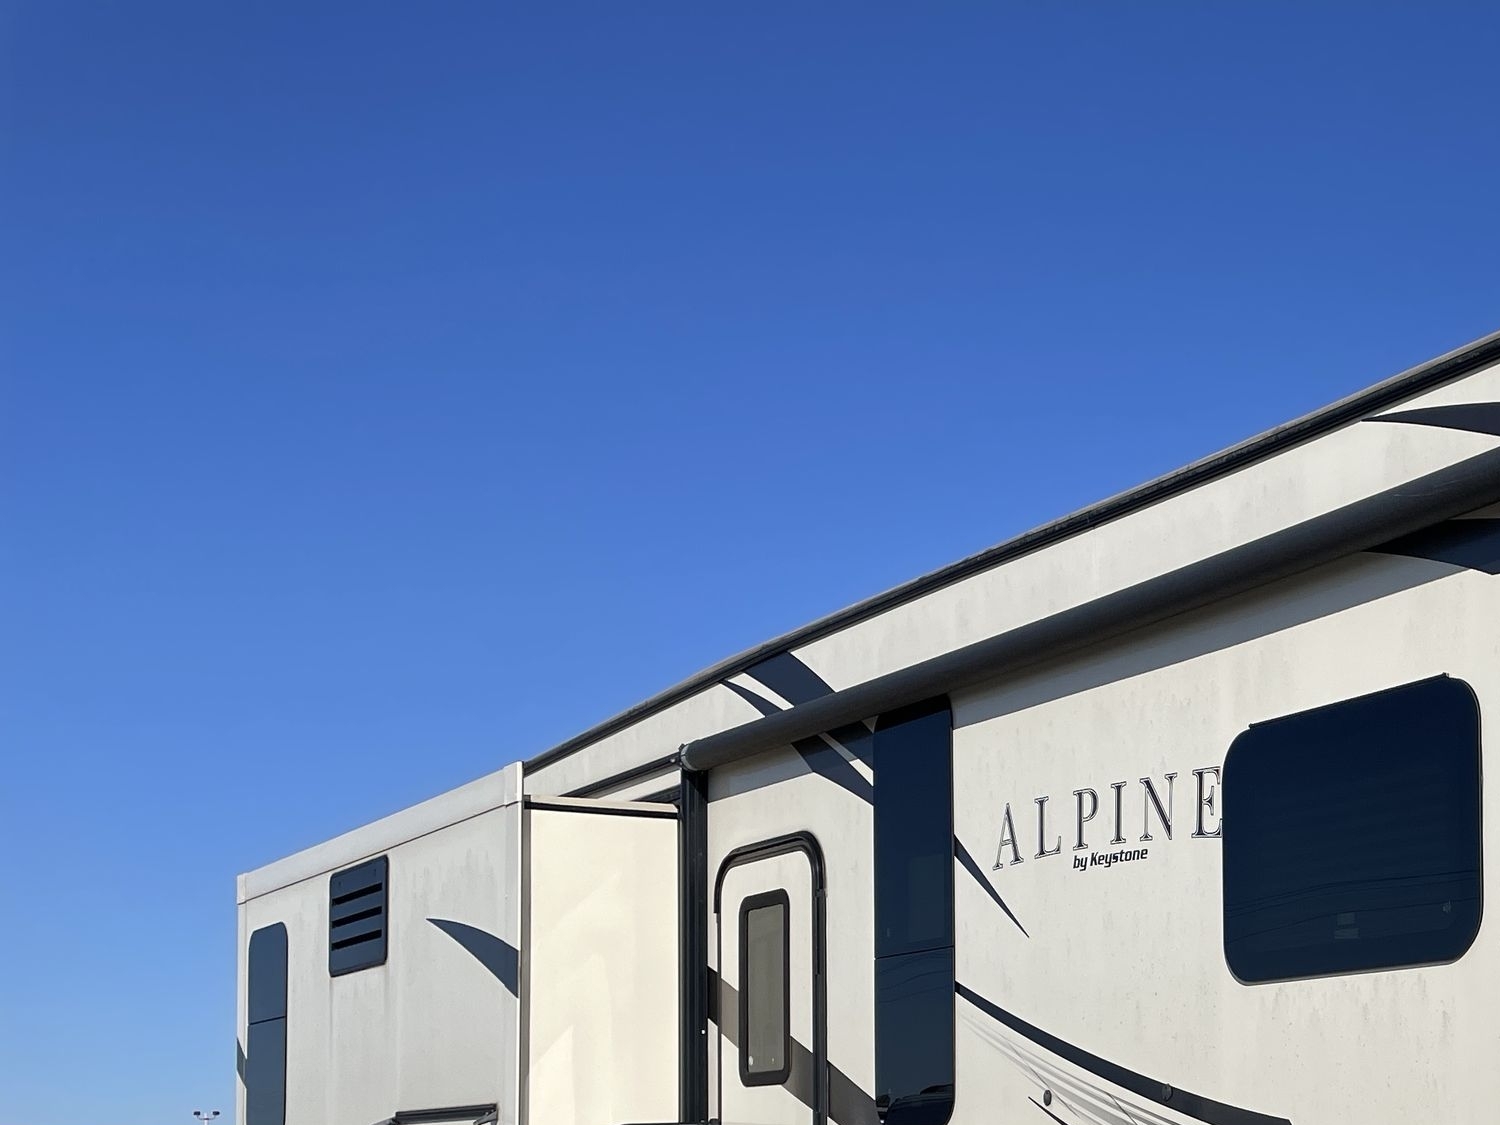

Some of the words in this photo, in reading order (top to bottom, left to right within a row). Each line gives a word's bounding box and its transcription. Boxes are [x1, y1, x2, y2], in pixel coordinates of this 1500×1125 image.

[993, 766, 1223, 870] ALPINE
[1072, 855, 1088, 871] by
[1090, 848, 1148, 868] Keystone
